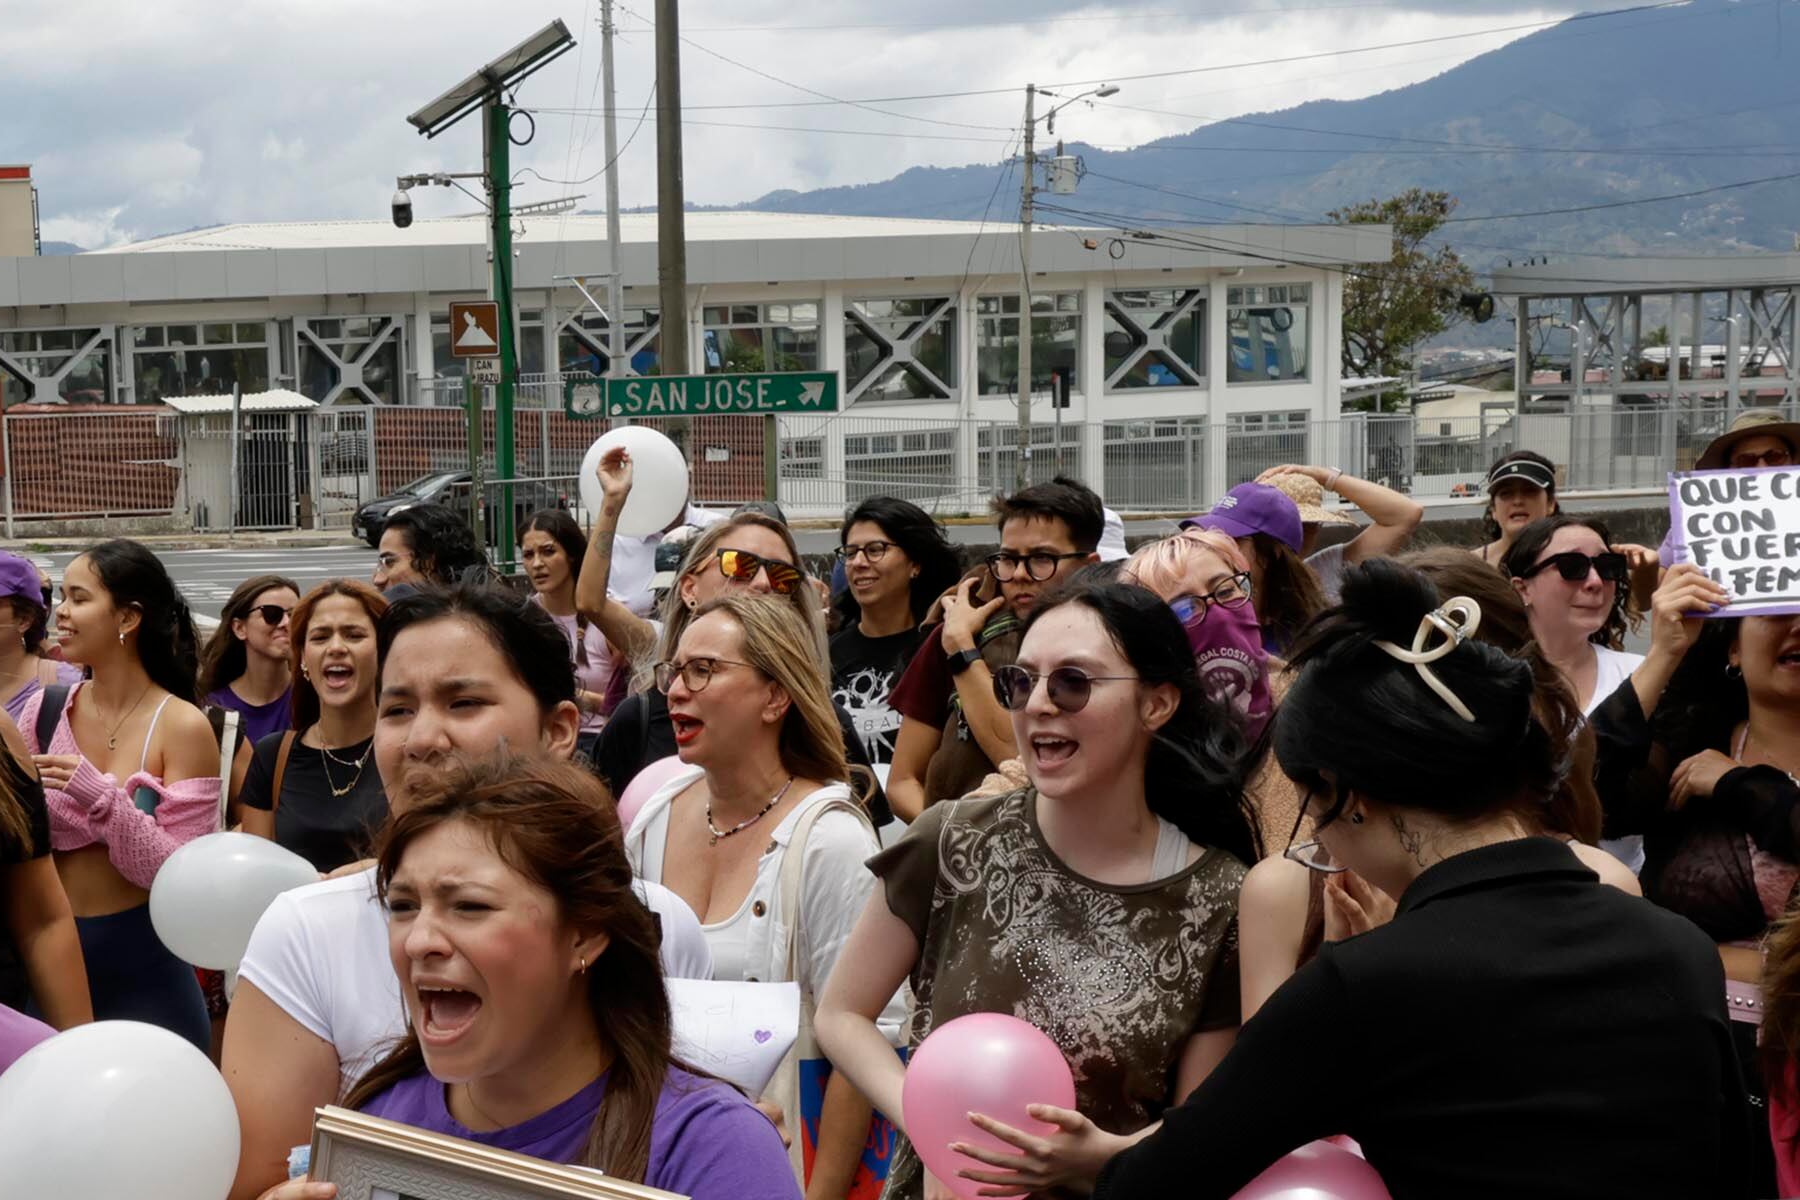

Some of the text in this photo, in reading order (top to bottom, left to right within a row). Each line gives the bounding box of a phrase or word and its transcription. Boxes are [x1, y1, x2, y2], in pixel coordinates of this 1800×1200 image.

[625, 378, 774, 412] SAN JOSE
[1680, 472, 1800, 507] QUE C
[1687, 508, 1776, 538] CON
[1220, 647, 1249, 665] COSTA
